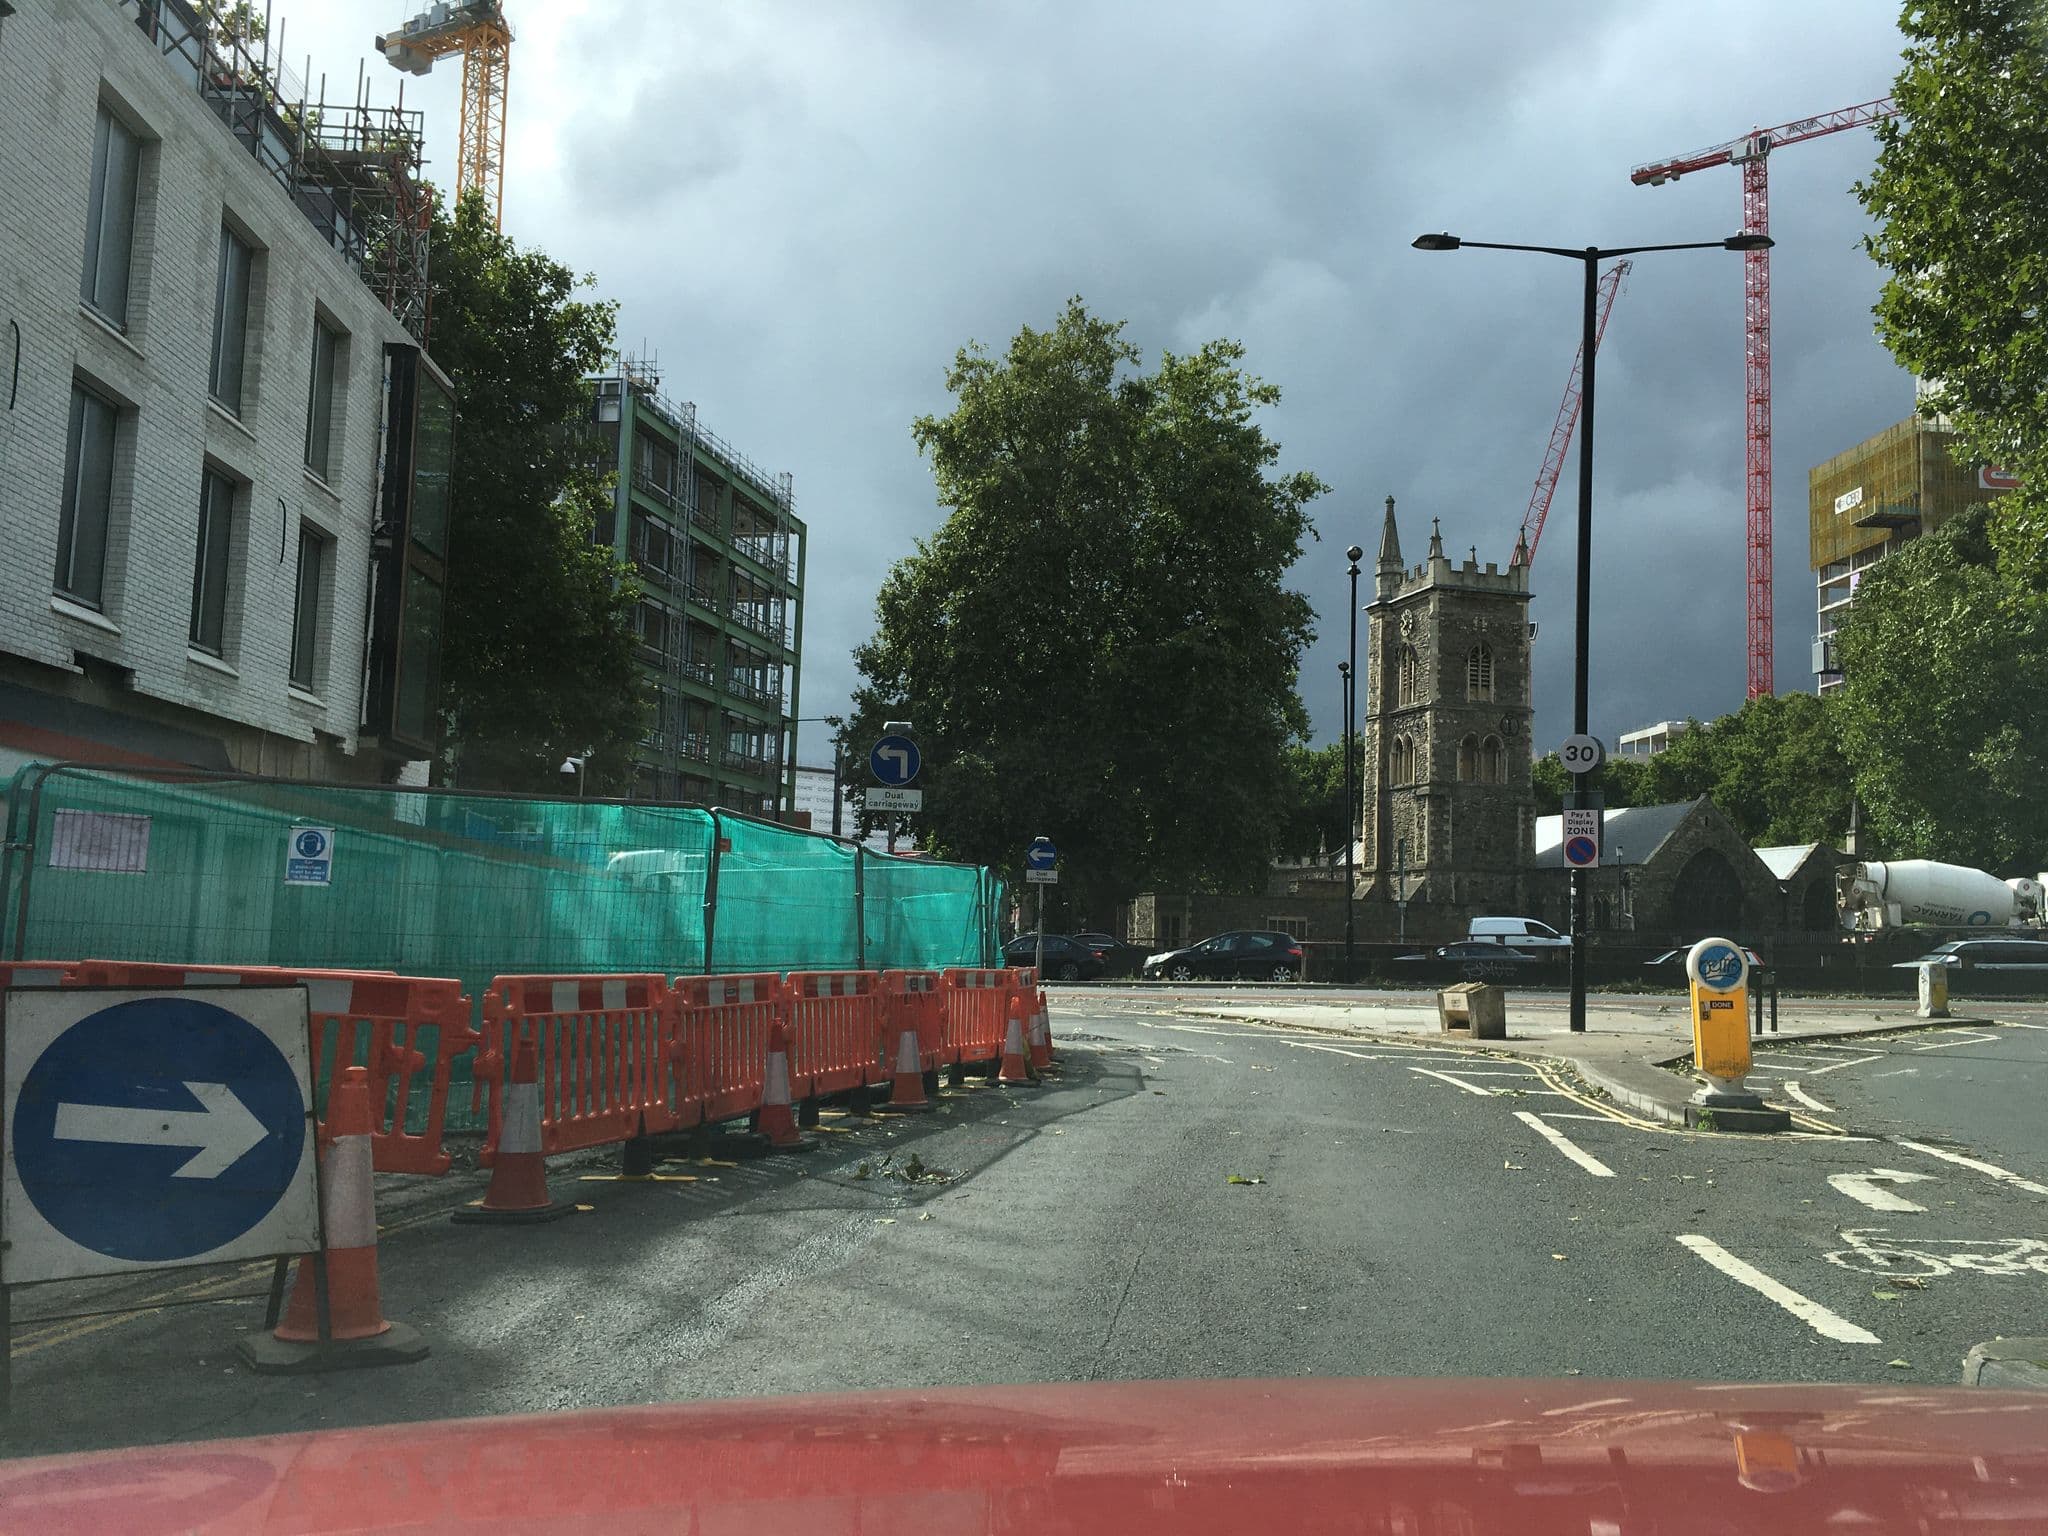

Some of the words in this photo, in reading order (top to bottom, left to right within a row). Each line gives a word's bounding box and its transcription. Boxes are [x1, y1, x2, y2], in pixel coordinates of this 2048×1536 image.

[1565, 745, 1594, 762] 30
[885, 791, 904, 799] Dual
[868, 800, 919, 810] carriageway
[1567, 827, 1595, 835] ZONE
[1912, 905, 1962, 921] TARMAC
[1711, 1001, 1732, 1009] DONE
